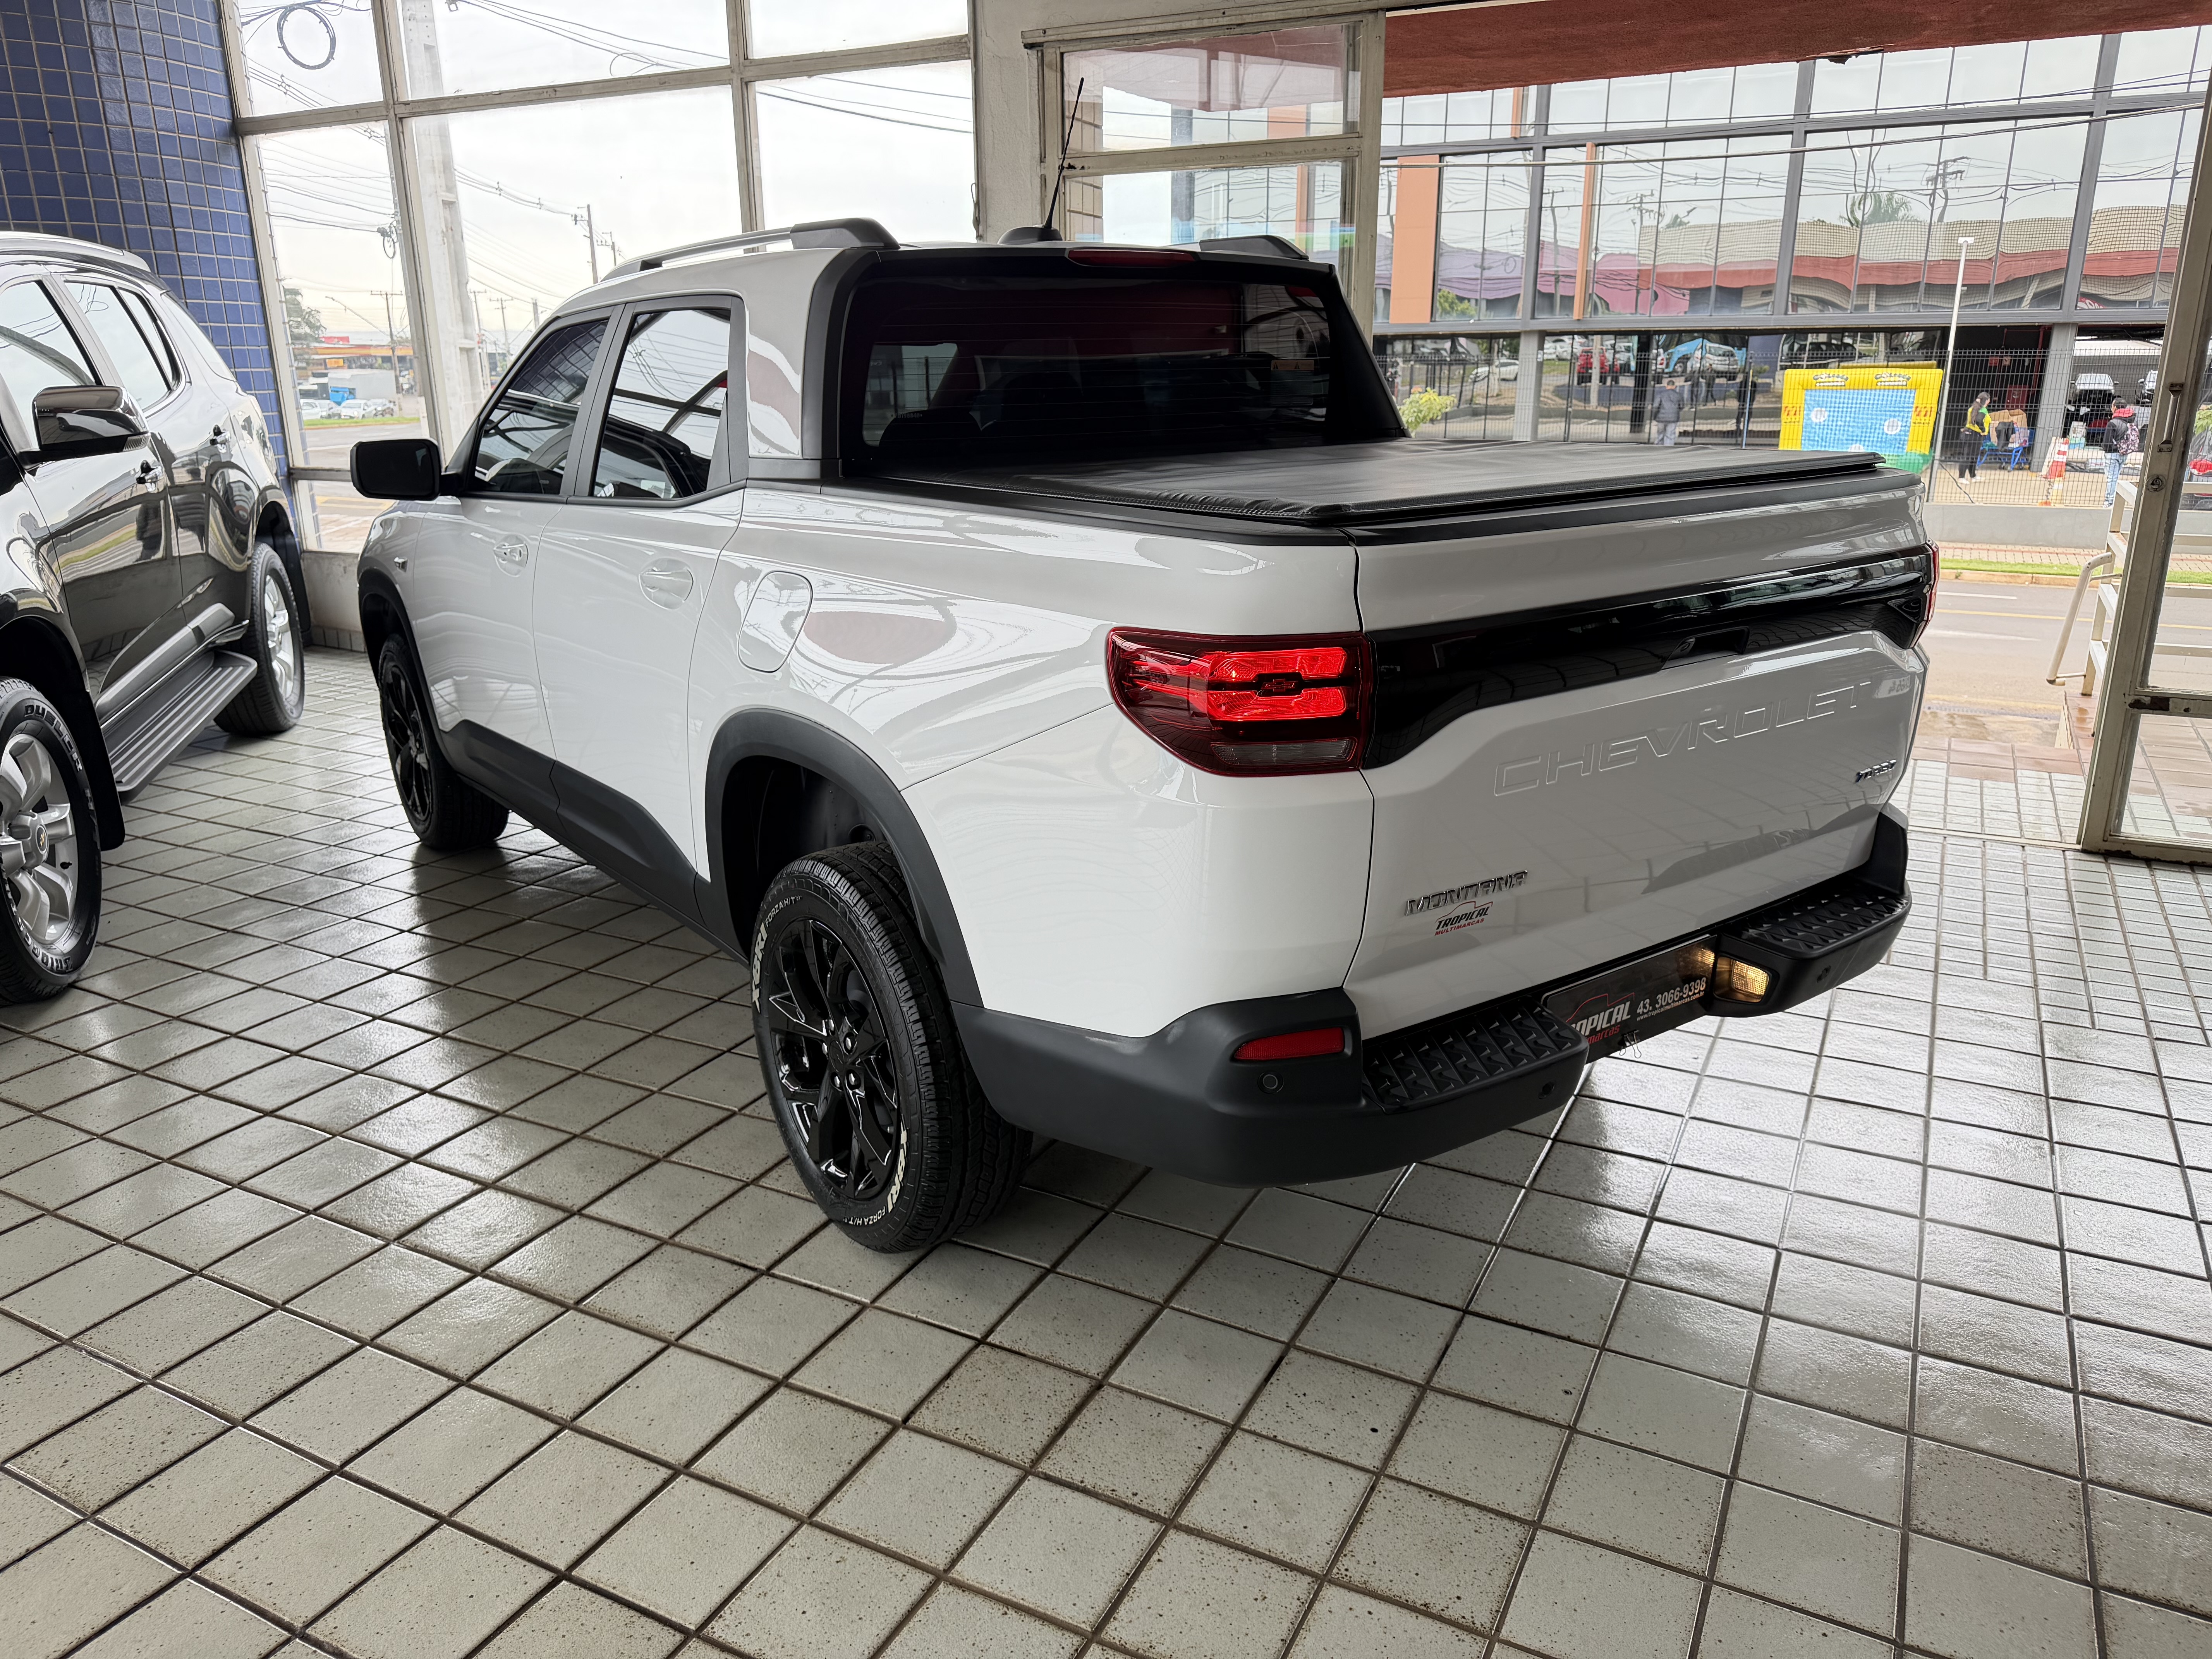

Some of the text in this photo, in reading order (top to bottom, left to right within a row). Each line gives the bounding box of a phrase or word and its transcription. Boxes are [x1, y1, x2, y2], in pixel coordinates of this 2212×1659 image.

[24, 704, 83, 771] DUELER
[1494, 681, 1871, 796] CHEVROLET
[1404, 870, 1528, 917] MONTANA
[0, 863, 73, 972] BRIDGESTON
[1434, 918, 1485, 936] MULTIMARCAS
[1436, 906, 1490, 930] TROPICAL
[752, 922, 768, 1013] XBRI
[765, 902, 784, 927] FORZA
[1637, 977, 1706, 1015] 43. 3066-9398
[1637, 991, 1705, 1021] www.tropicalmultimarcas.com.br
[1571, 1001, 1632, 1040] OPICAL
[1587, 1025, 1621, 1044] marcas
[848, 1216, 862, 1226] H/T
[864, 1206, 886, 1225] FORZA
